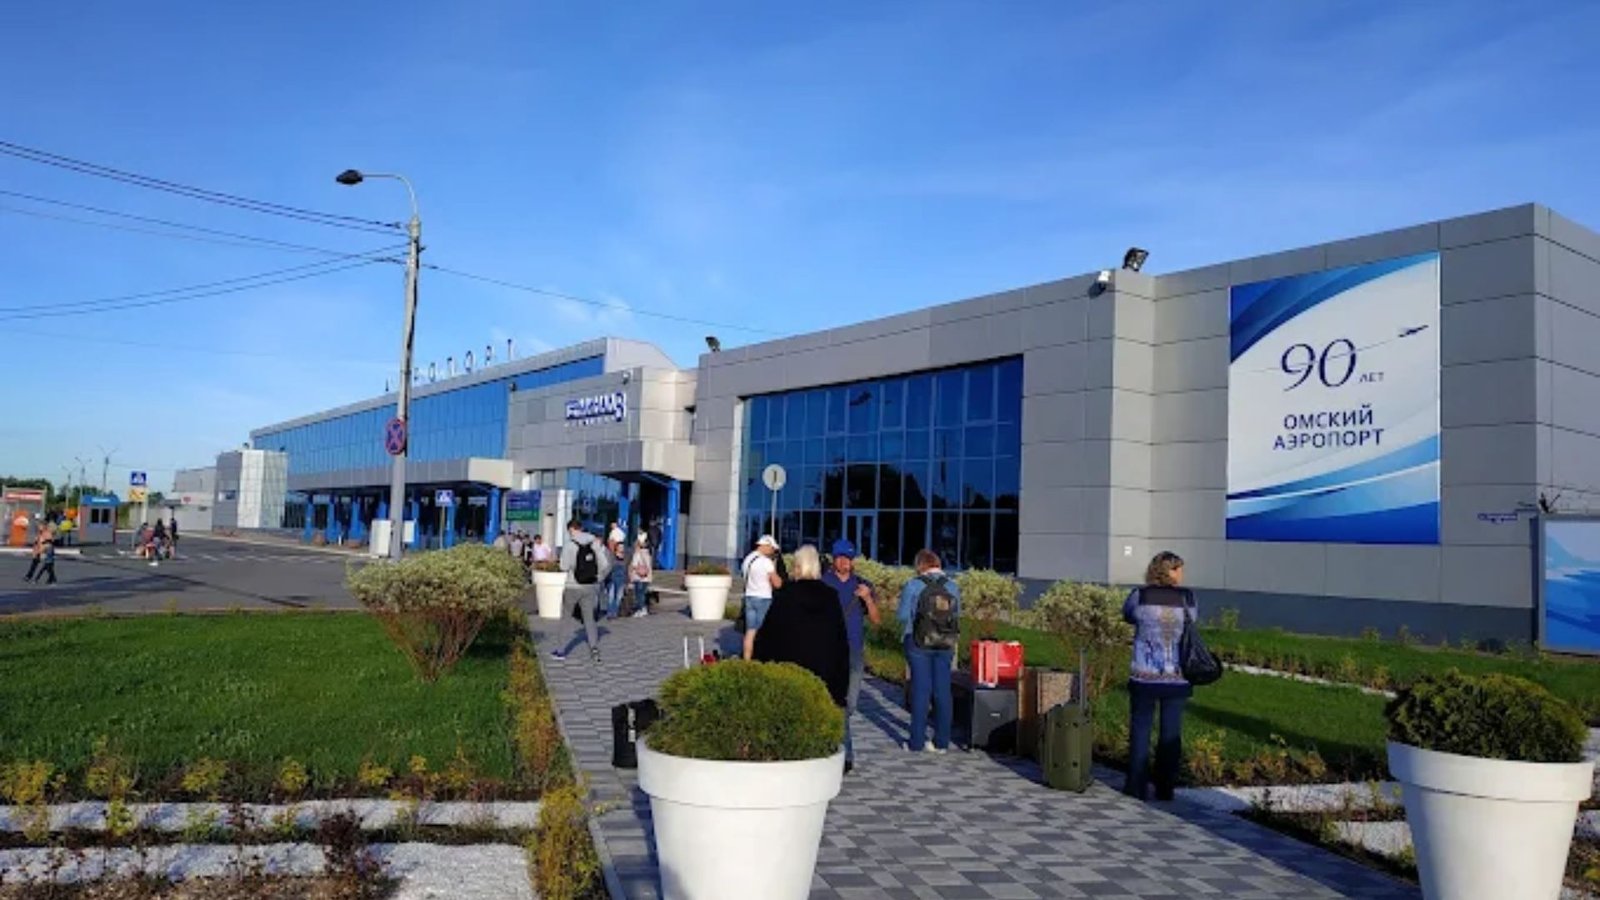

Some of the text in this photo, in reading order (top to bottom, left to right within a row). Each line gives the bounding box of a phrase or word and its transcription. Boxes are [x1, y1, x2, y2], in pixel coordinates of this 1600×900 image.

[1281, 338, 1384, 391] 90 ЛЕТ
[1284, 403, 1373, 430] ОМСКИЙ
[1272, 428, 1385, 450] АЭРОПОРТ
